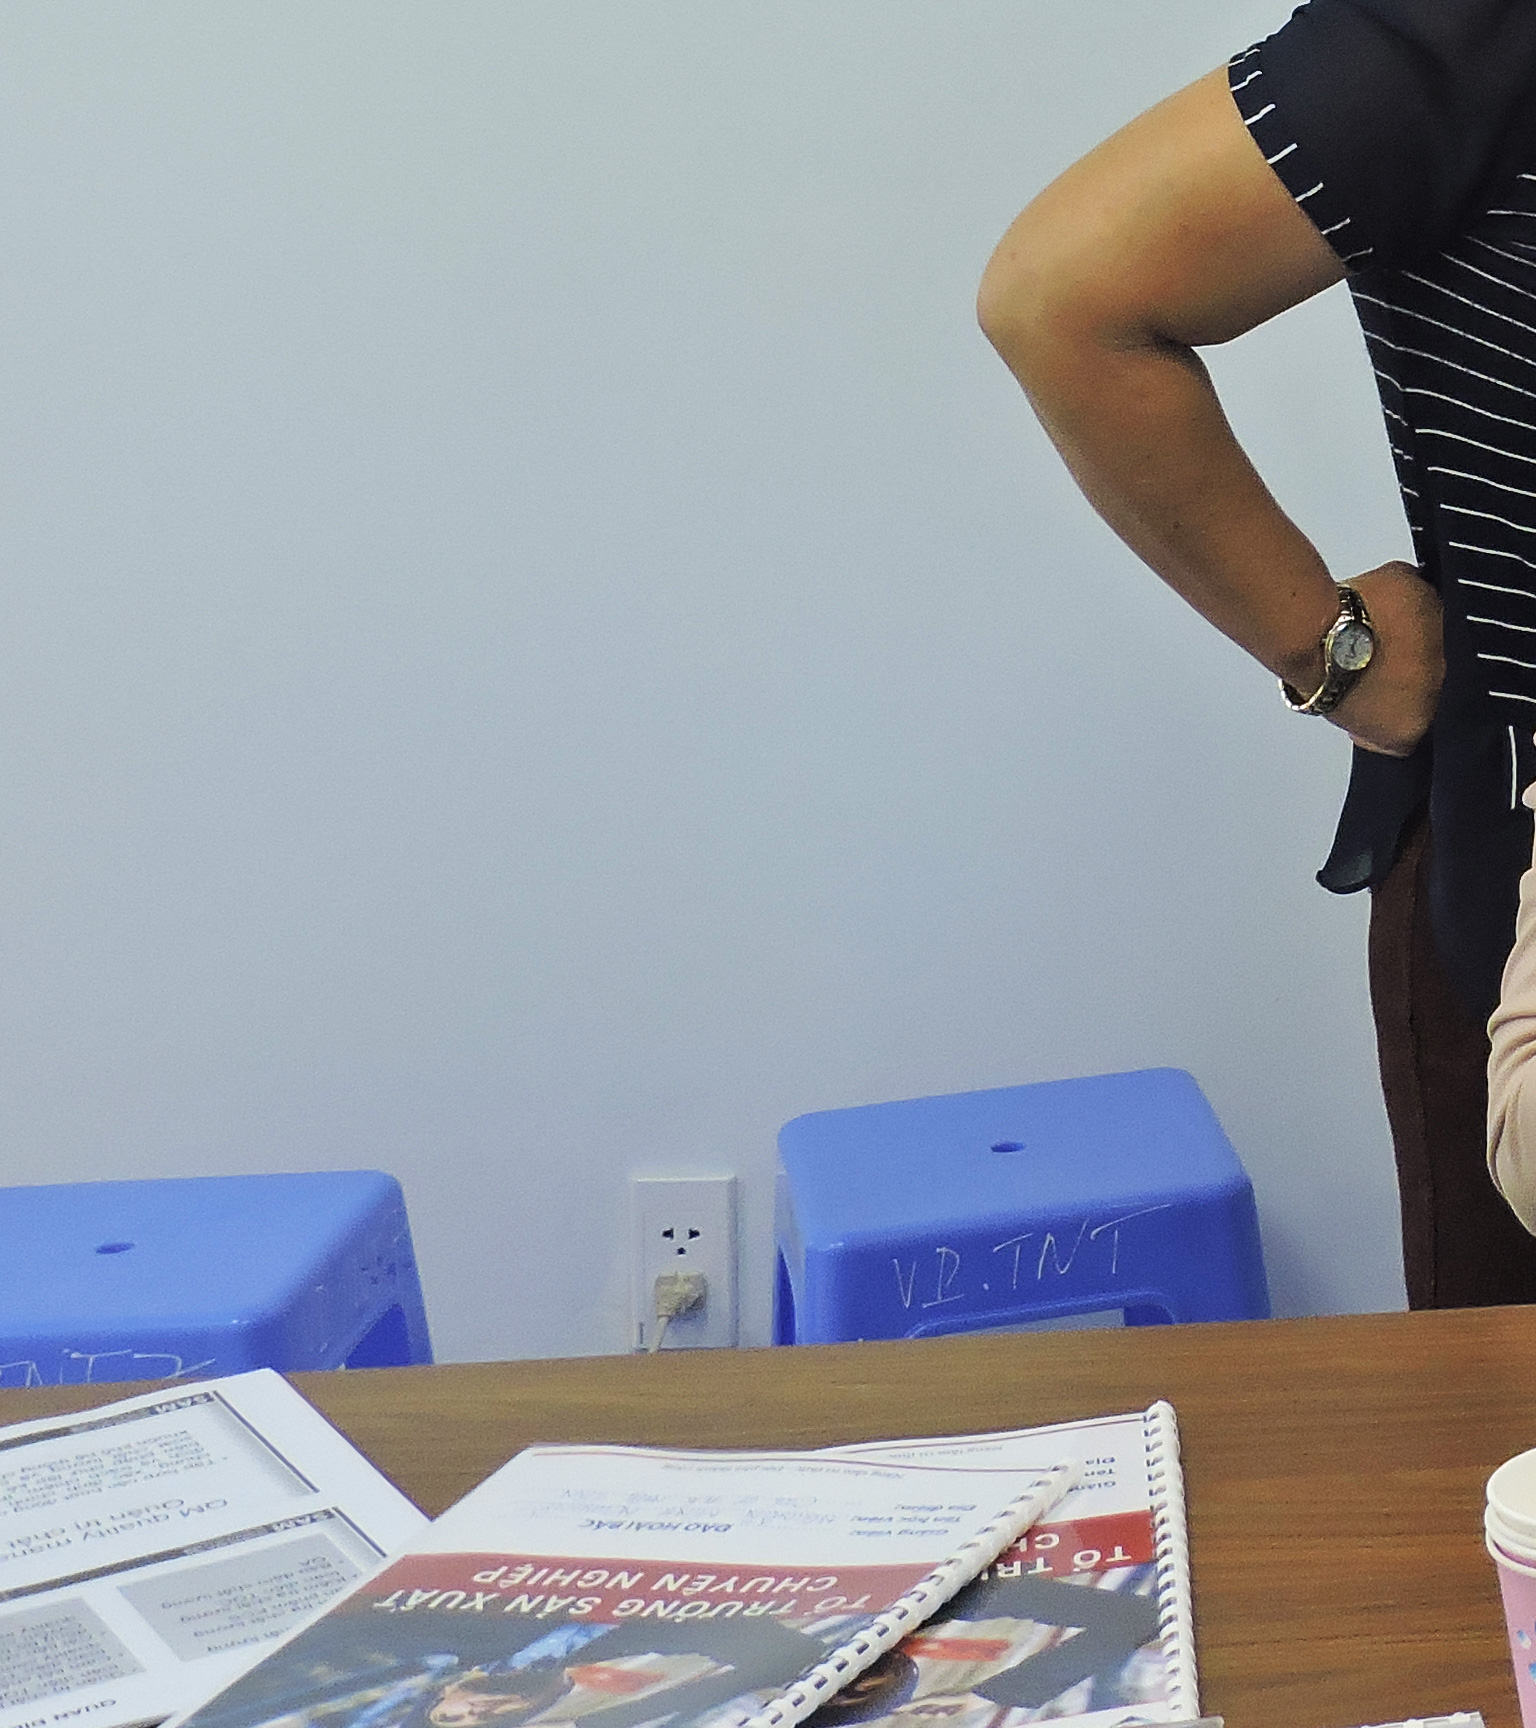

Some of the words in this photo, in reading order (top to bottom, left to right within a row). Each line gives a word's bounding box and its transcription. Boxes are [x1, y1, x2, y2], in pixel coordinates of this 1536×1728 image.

[1073, 1546, 1132, 1570] TỔ
[473, 1563, 644, 1591] NGHIỆP
[652, 1572, 838, 1597] CHUYÊN
[374, 1588, 486, 1612] XUẤT
[505, 1595, 602, 1619] SẢN
[612, 1597, 798, 1621] TRƯỞNG
[815, 1593, 872, 1615] TỔ
